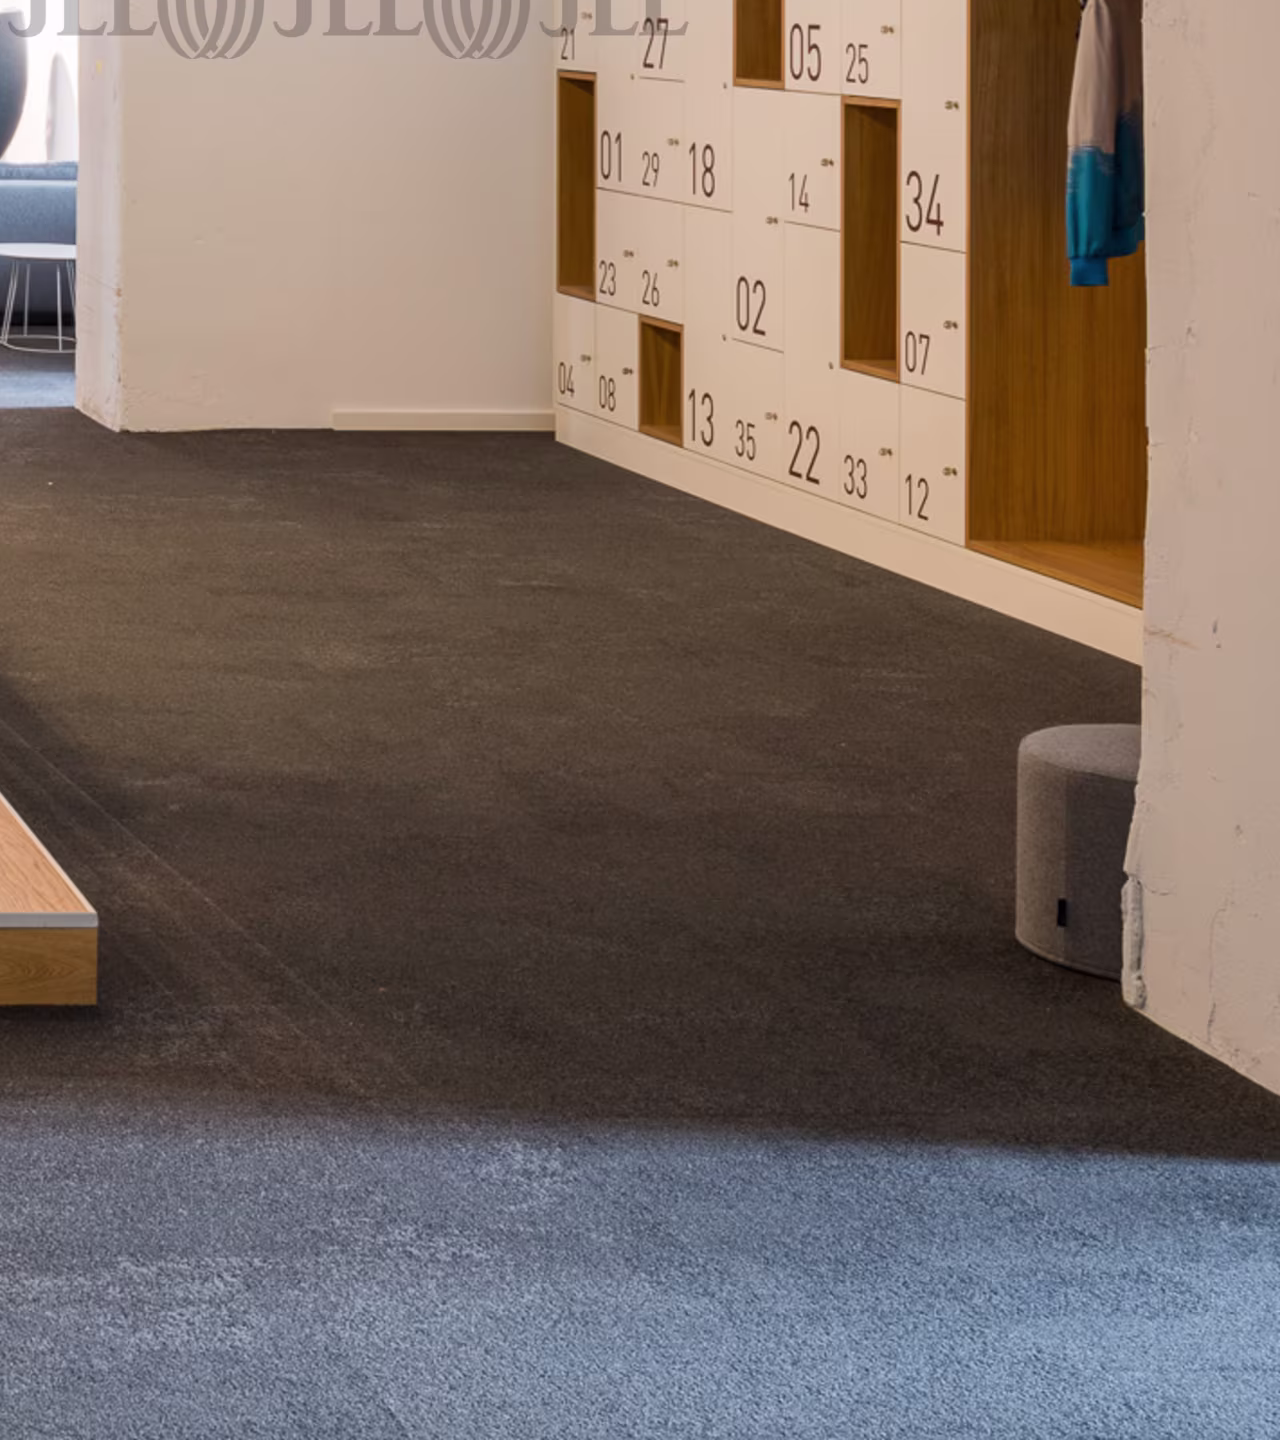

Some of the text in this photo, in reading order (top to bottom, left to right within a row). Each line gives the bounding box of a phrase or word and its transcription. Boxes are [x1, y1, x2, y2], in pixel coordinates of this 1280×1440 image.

[559, 26, 575, 61] 21
[642, 16, 669, 69] 27
[789, 23, 822, 82] 05
[845, 42, 869, 85] 25
[597, 129, 624, 185] 01
[642, 151, 660, 187] 29
[688, 142, 716, 198] 18
[788, 172, 810, 212] 14
[905, 170, 944, 236] 34
[598, 259, 617, 298] 23
[642, 269, 660, 307] 26
[736, 276, 766, 337] 02
[905, 330, 931, 375] 07
[558, 361, 576, 398] 04
[599, 375, 616, 412] 08
[687, 388, 714, 447] 13
[735, 419, 756, 461] 35
[788, 420, 820, 485] 22
[843, 454, 867, 500] 33
[905, 473, 929, 521] 12
